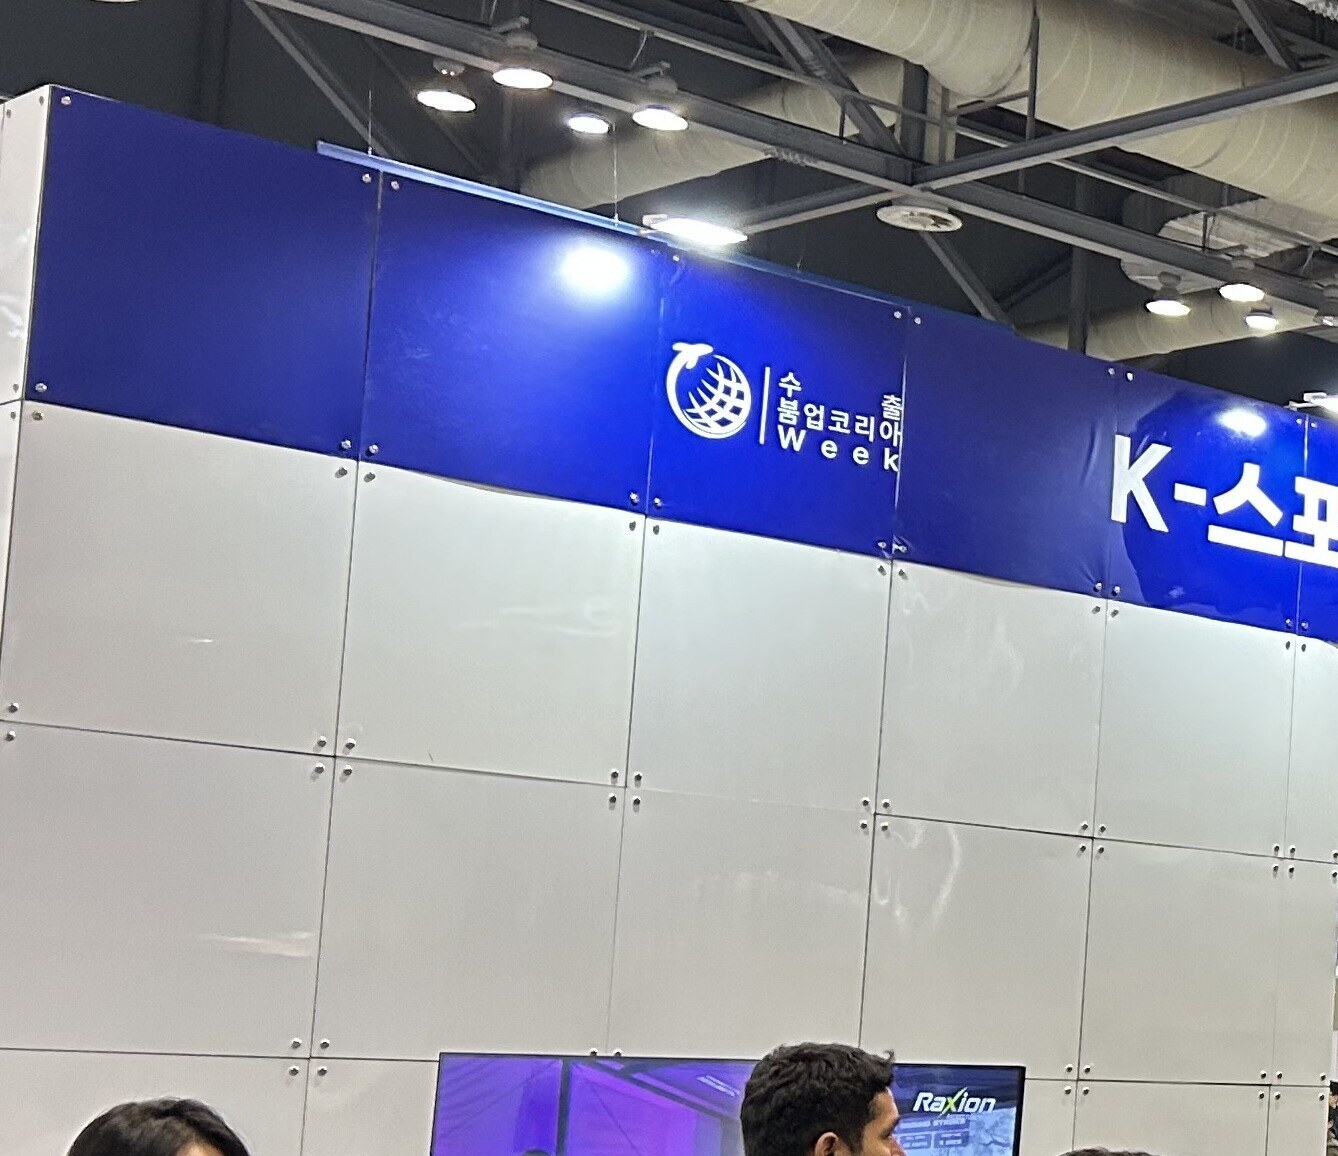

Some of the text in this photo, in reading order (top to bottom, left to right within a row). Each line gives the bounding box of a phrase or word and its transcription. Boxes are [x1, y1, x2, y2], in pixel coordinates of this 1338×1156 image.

[777, 397, 903, 446] 붐업코리아
[777, 425, 900, 471] Week
[913, 1087, 996, 1118] Raxion
